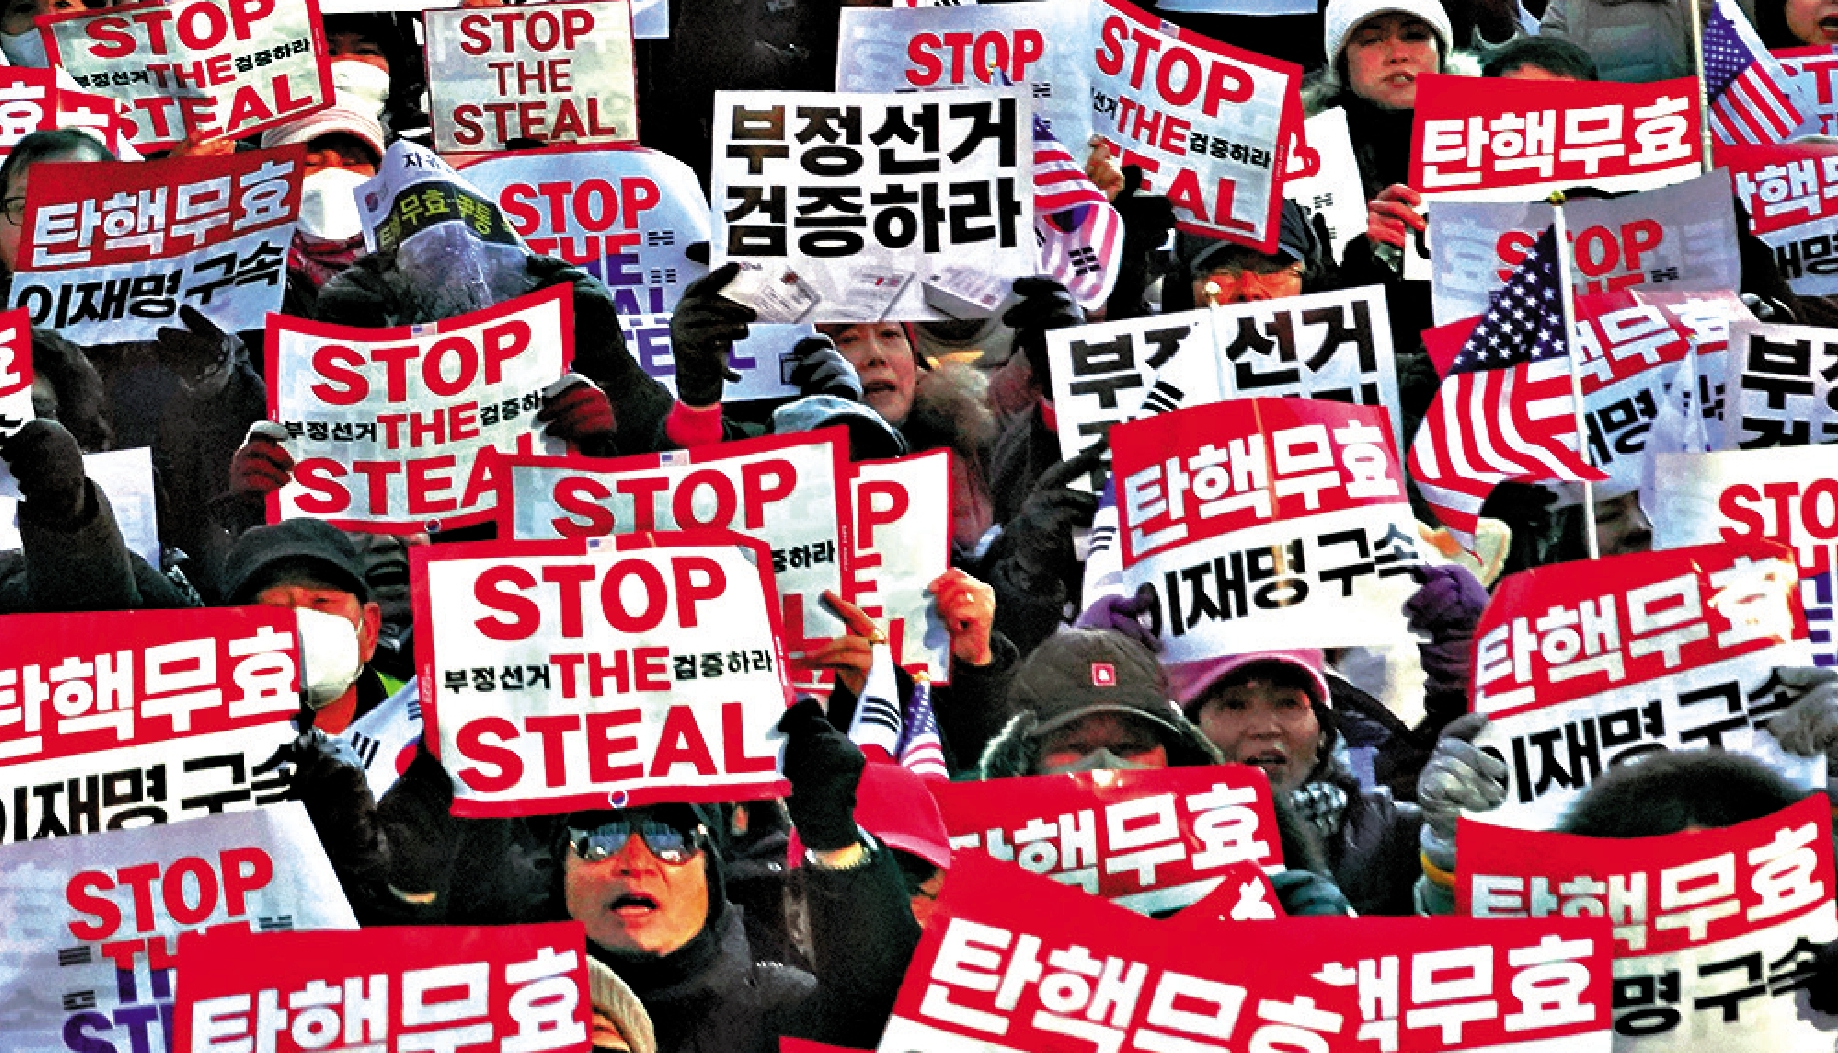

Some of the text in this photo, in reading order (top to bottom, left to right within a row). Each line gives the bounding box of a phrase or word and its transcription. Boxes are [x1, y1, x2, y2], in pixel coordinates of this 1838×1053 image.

[461, 11, 595, 55] STOP
[906, 29, 1045, 86] STOP
[1096, 15, 1254, 119] STOP
[488, 60, 572, 94] THE
[453, 101, 616, 147] STEAL
[726, 102, 1019, 177] 부정선거
[1422, 96, 1701, 190] 탄핵무효
[32, 159, 295, 267] 탄핵무효
[727, 179, 1021, 257] 검증하라
[18, 241, 284, 330] 이재명 구속
[311, 320, 531, 405] STOP
[285, 403, 478, 449] 부정선거 THE
[553, 457, 796, 540] STOP
[1125, 421, 1402, 556] 탄핵무효
[473, 553, 727, 639] STOP
[1476, 559, 1796, 713] 탄핵무효
[443, 645, 773, 698] 부정선거 THE 검증하라
[455, 701, 776, 792] STEAL
[65, 847, 274, 941] STOP
